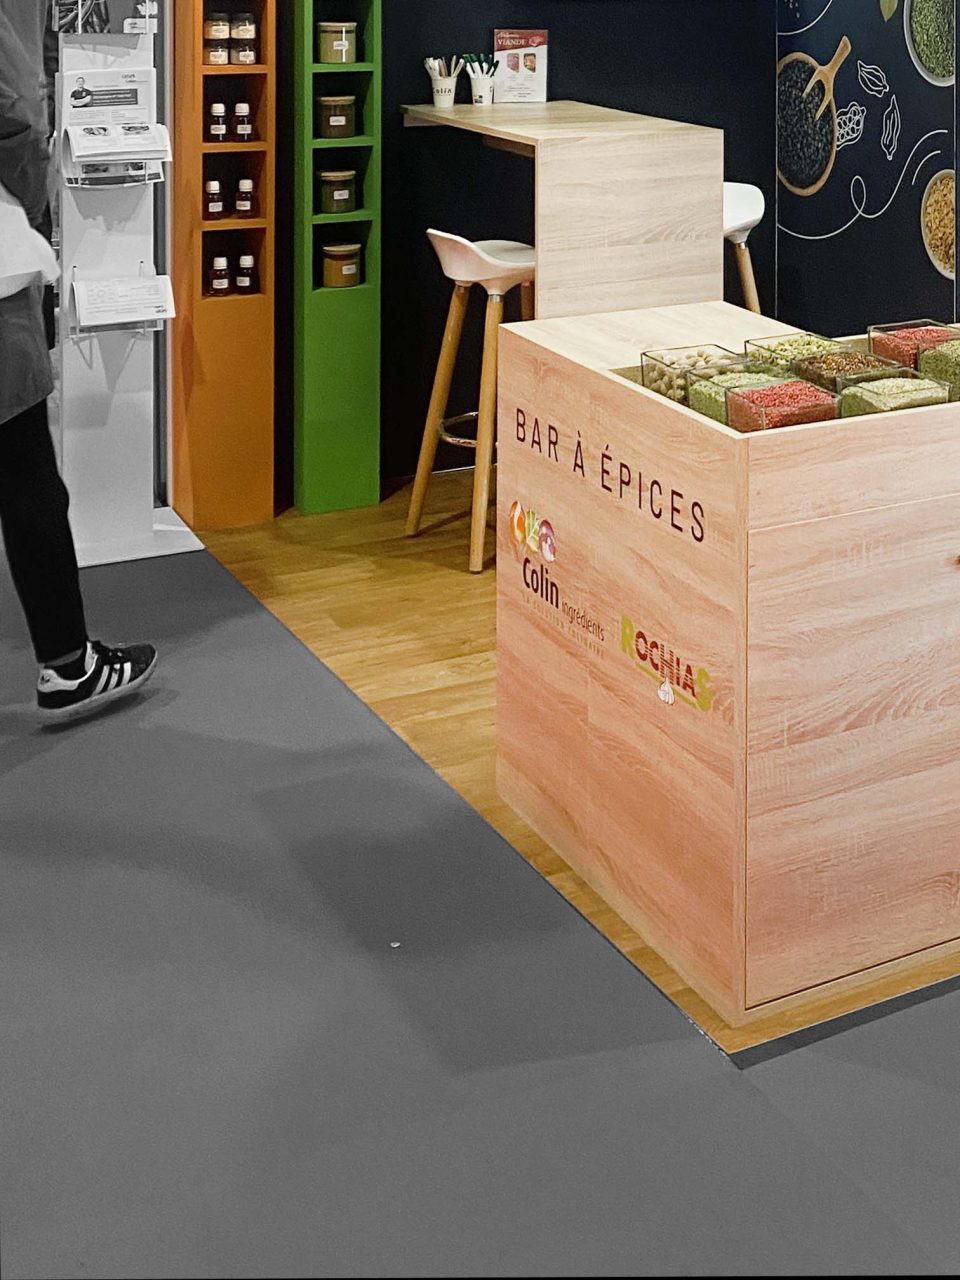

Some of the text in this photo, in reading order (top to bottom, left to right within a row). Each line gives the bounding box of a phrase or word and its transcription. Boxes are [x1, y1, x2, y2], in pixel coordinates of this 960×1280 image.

[516, 408, 705, 543] BAR À ÉPICES
[523, 557, 559, 610] Colin
[561, 600, 605, 642] ingrédients
